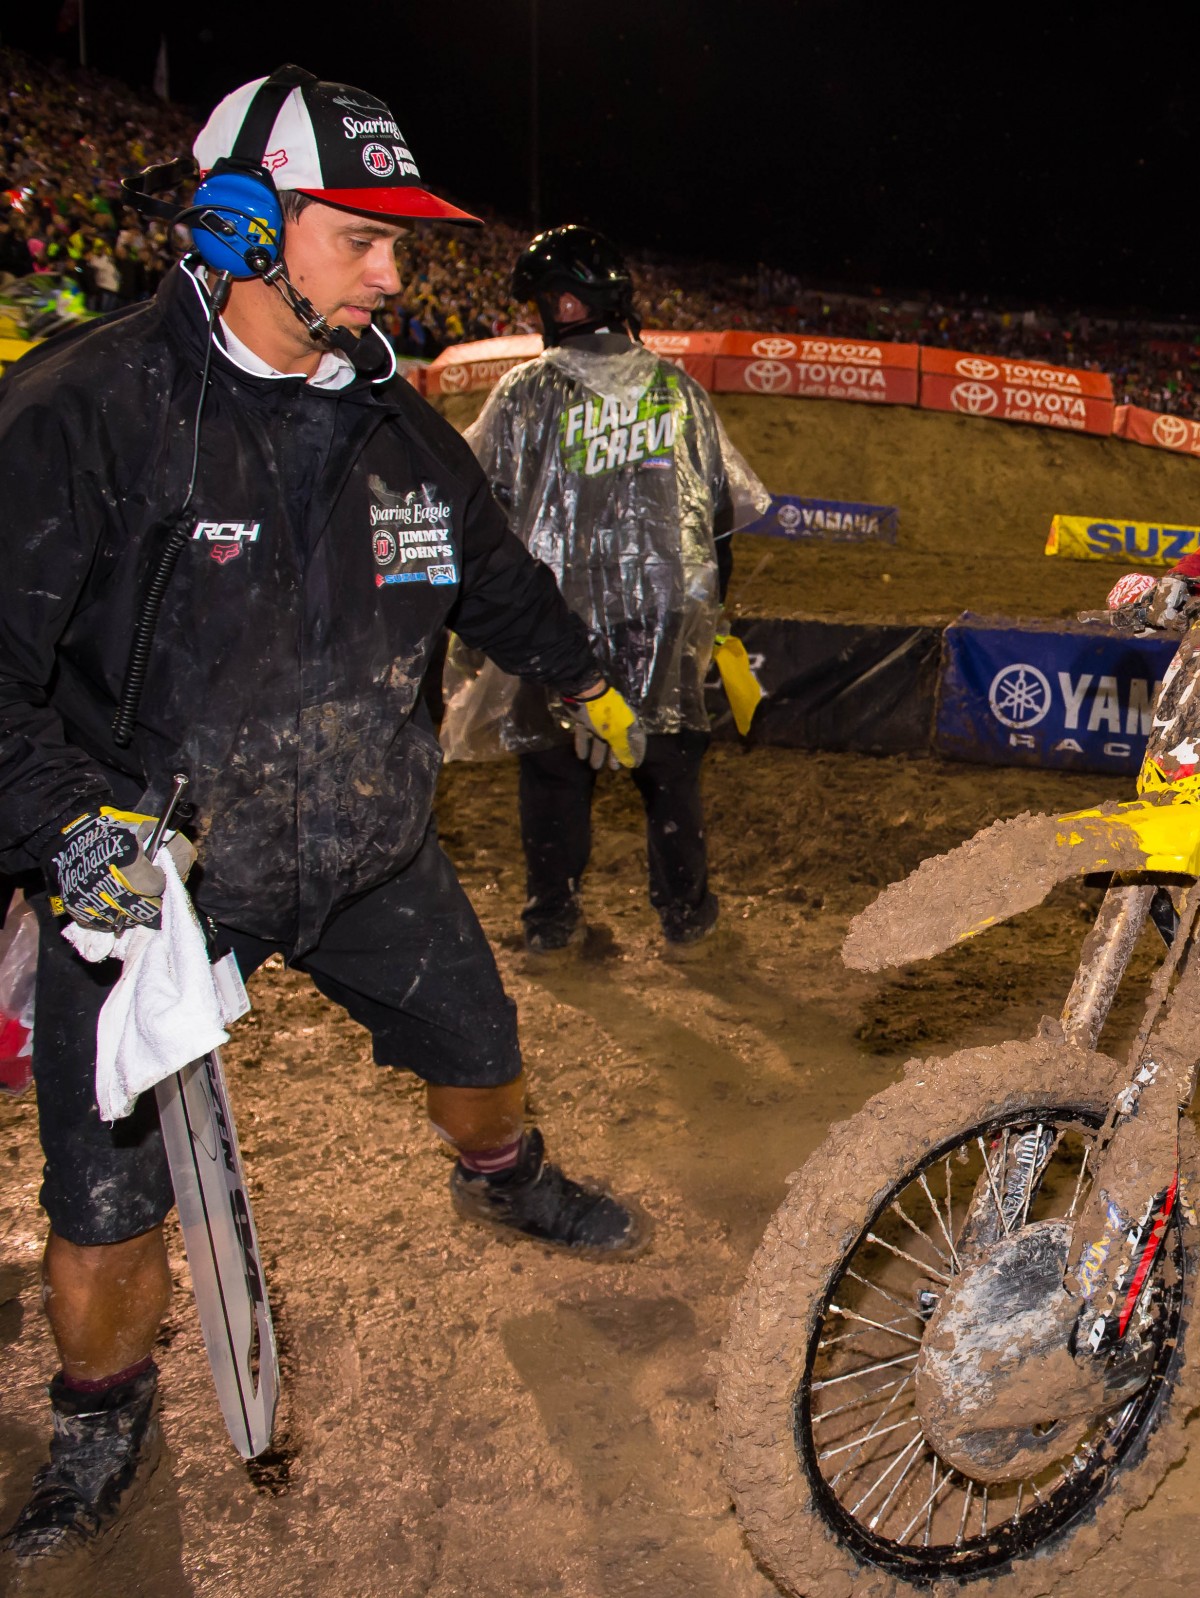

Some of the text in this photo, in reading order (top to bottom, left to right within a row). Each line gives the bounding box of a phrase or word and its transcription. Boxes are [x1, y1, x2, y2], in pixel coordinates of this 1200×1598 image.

[342, 116, 401, 140] Soaring
[801, 340, 882, 359] TOYOTA
[796, 363, 887, 387] TOYOTA
[1001, 363, 1081, 386] TOYOTA
[828, 385, 846, 397] Go
[1002, 387, 1086, 417] TOYOTA
[1004, 407, 1031, 421] Let's
[1033, 411, 1051, 423] Go
[585, 411, 677, 476] CREW
[370, 501, 451, 526] Soaring Eagle
[802, 508, 879, 534] YAMAHA
[192, 522, 260, 541] RCH
[399, 528, 449, 547] JIMMY
[400, 544, 454, 563] JOHN'S
[60, 834, 123, 899] Mechanix
[229, 1188, 265, 1310] 94
